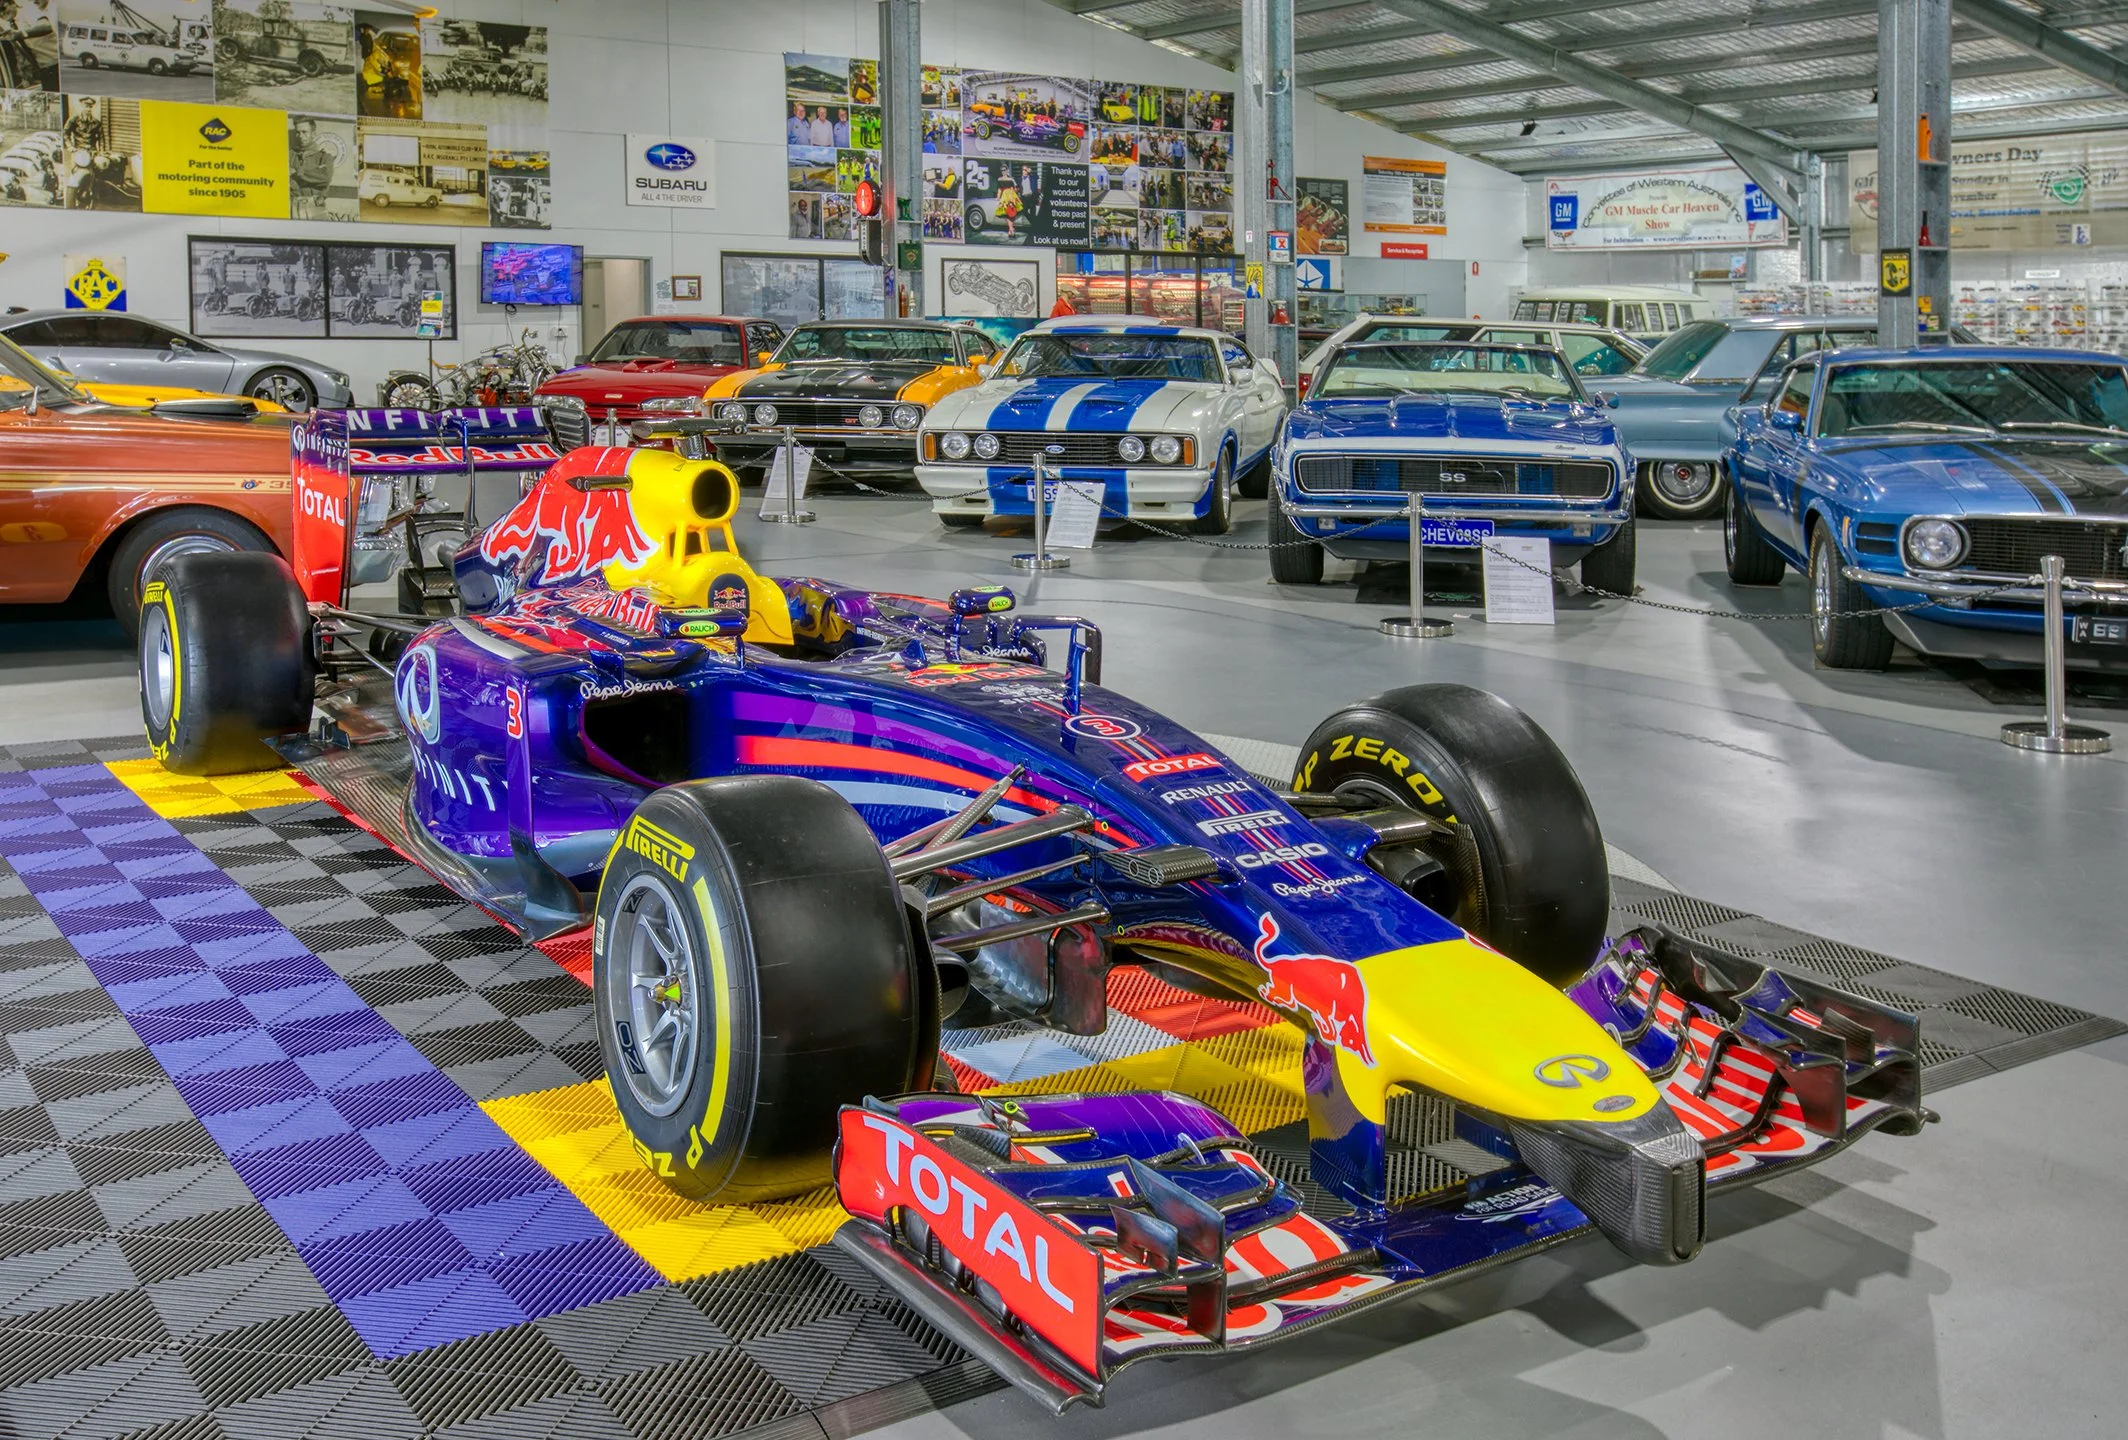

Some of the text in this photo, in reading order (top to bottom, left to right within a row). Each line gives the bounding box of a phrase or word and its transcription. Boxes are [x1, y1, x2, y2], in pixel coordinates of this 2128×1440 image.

[204, 127, 227, 136] RAC
[2007, 147, 2043, 163] Day
[188, 160, 245, 171] Part of the
[1051, 166, 1087, 177] Thank you
[158, 172, 275, 188] motoring community
[966, 160, 990, 190] 25
[1951, 174, 2009, 186] Sunday in
[635, 177, 707, 191] SUBARU
[188, 187, 246, 199] since 1905
[662, 194, 676, 202] THE
[677, 194, 703, 203] DRIVER
[1052, 188, 1085, 198] wonderful
[1050, 200, 1088, 208] volunteers
[1555, 202, 1572, 217] GM
[1582, 187, 1626, 228] Corvettes
[1626, 181, 1638, 193] of
[1637, 177, 1685, 188] Western
[1605, 202, 1720, 216] GM Muscle Car Heaven
[1051, 209, 1087, 219] those past
[1059, 221, 1086, 229] present
[1645, 219, 1671, 230] Show
[1033, 236, 1050, 244] Look
[1051, 237, 1059, 245] at
[73, 270, 118, 299] RAC
[350, 443, 560, 465] Red Bull
[1439, 472, 1467, 483] SS
[297, 477, 345, 528] TOTAL
[714, 600, 746, 609] Red Bull
[995, 599, 1009, 607] RAUCH
[690, 624, 715, 633] RAUCH
[983, 646, 1031, 658] Jeans
[904, 667, 1048, 687] Red Bull
[580, 679, 676, 700] Pepe Jeans
[507, 686, 522, 739] 3
[1080, 717, 1127, 736] 3
[1126, 755, 1221, 776] TOTAL
[1304, 735, 1443, 805] P ZERO
[1159, 781, 1252, 805] RENAULT
[1196, 809, 1291, 837] PIRELLI
[625, 814, 696, 883] PIRELLI
[1235, 842, 1329, 868] CASIO
[1272, 873, 1368, 899] Pepe Jeans
[686, 1124, 704, 1170] P
[1486, 1183, 1541, 1203] ACTION
[1494, 1196, 1529, 1210] ROAD
[863, 1115, 1075, 1314] TOTAL
